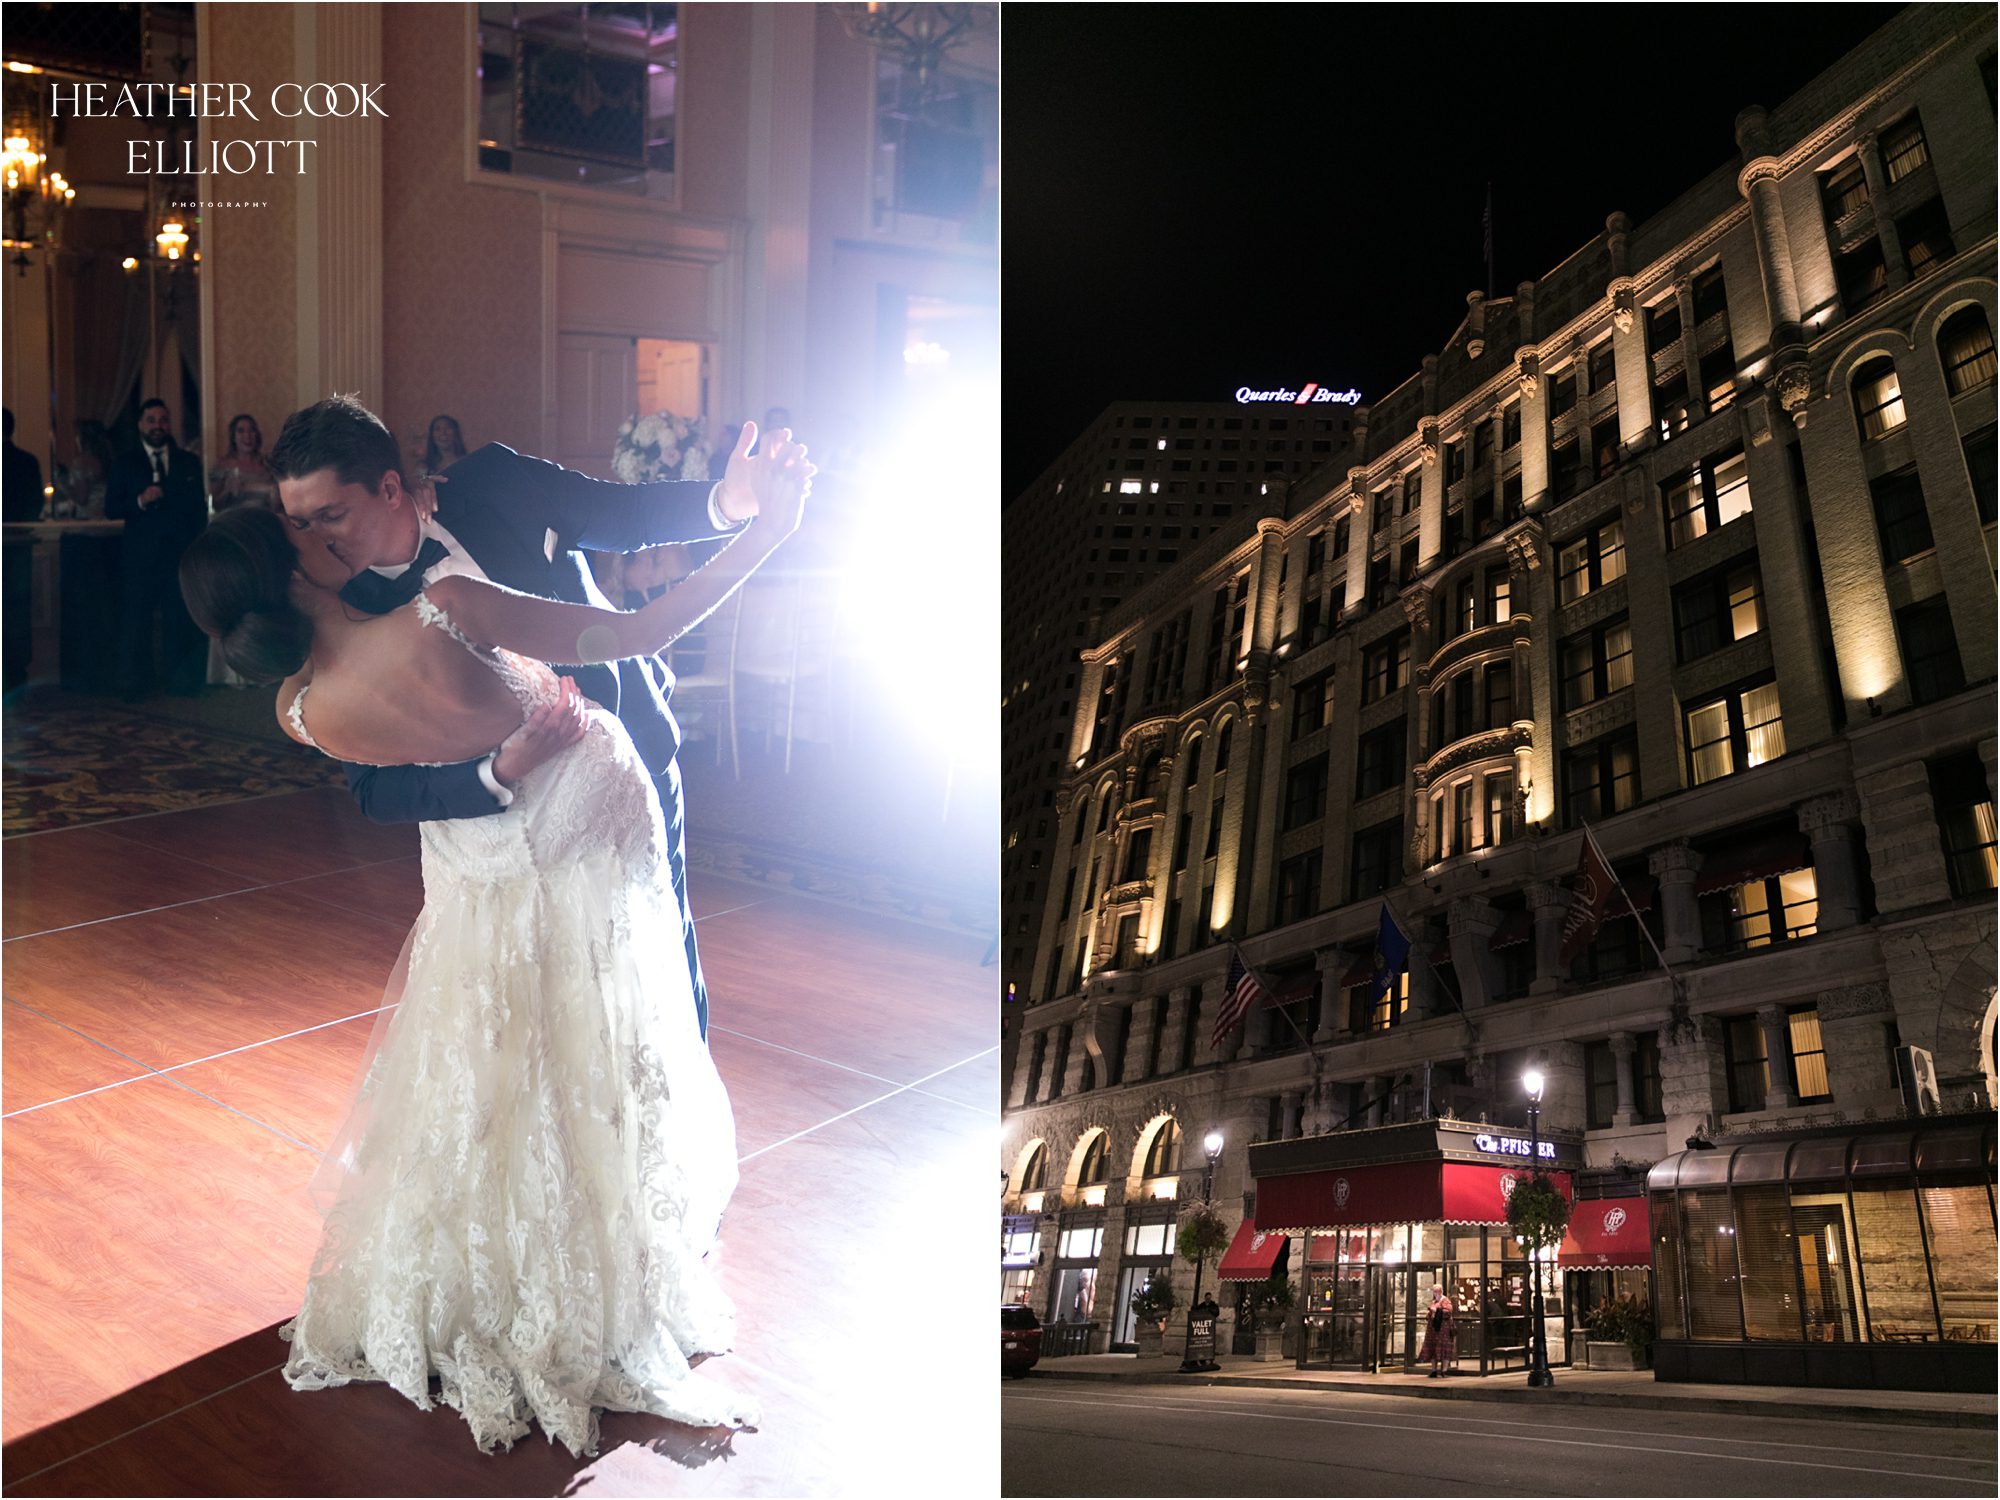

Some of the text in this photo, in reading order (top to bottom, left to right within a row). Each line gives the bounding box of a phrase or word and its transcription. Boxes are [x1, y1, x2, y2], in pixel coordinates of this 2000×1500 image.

[1235, 387, 1297, 404] Quarles
[1312, 388, 1361, 405] Brady
[1500, 1137, 1555, 1158] PFISER
[1191, 1319, 1213, 1328] VALET
[1193, 1327, 1210, 1335] FULL
